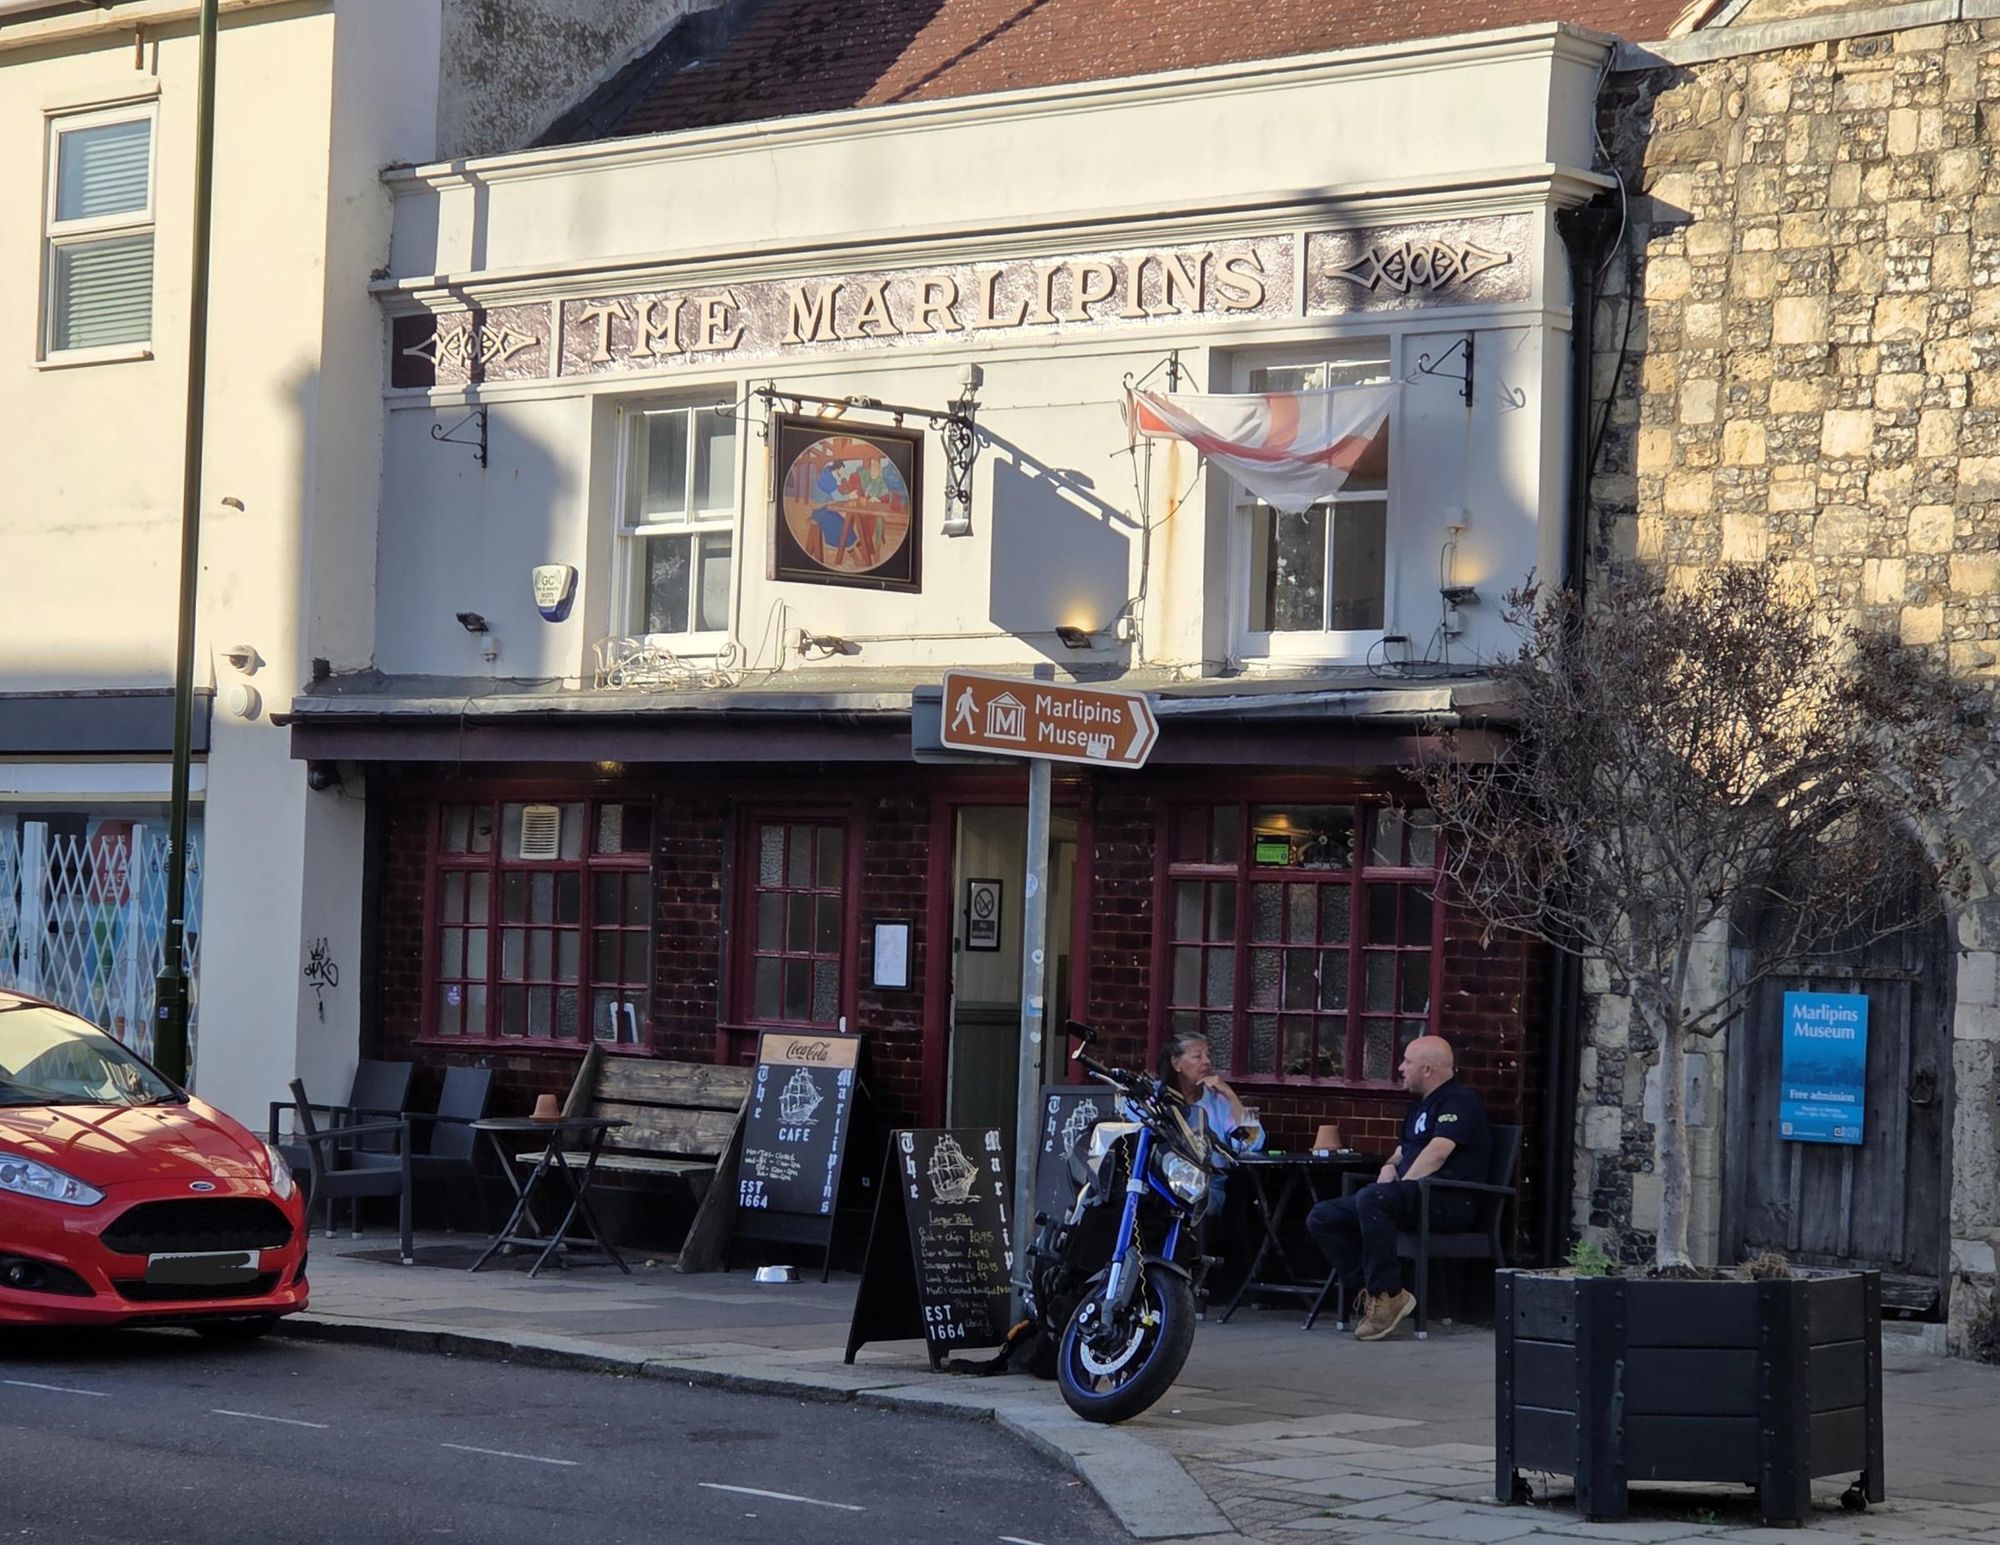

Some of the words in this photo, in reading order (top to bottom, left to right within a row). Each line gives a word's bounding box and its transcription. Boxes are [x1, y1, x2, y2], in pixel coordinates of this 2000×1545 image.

[579, 290, 745, 365] THE
[780, 248, 1266, 346] MARLIPINS
[1035, 694, 1122, 725] Marlipins
[1038, 723, 1115, 750] Museum
[1792, 1003, 1859, 1025] Marlipins
[1794, 1022, 1855, 1040] Museum
[1790, 1088, 1809, 1100] Free
[1810, 1090, 1856, 1102] admission
[778, 1127, 811, 1142] CAFE
[739, 1179, 764, 1194] EST
[739, 1193, 768, 1208] 1664
[985, 1130, 1014, 1271] Marlip
[925, 1304, 951, 1322] EST
[929, 1322, 965, 1341] 1664
